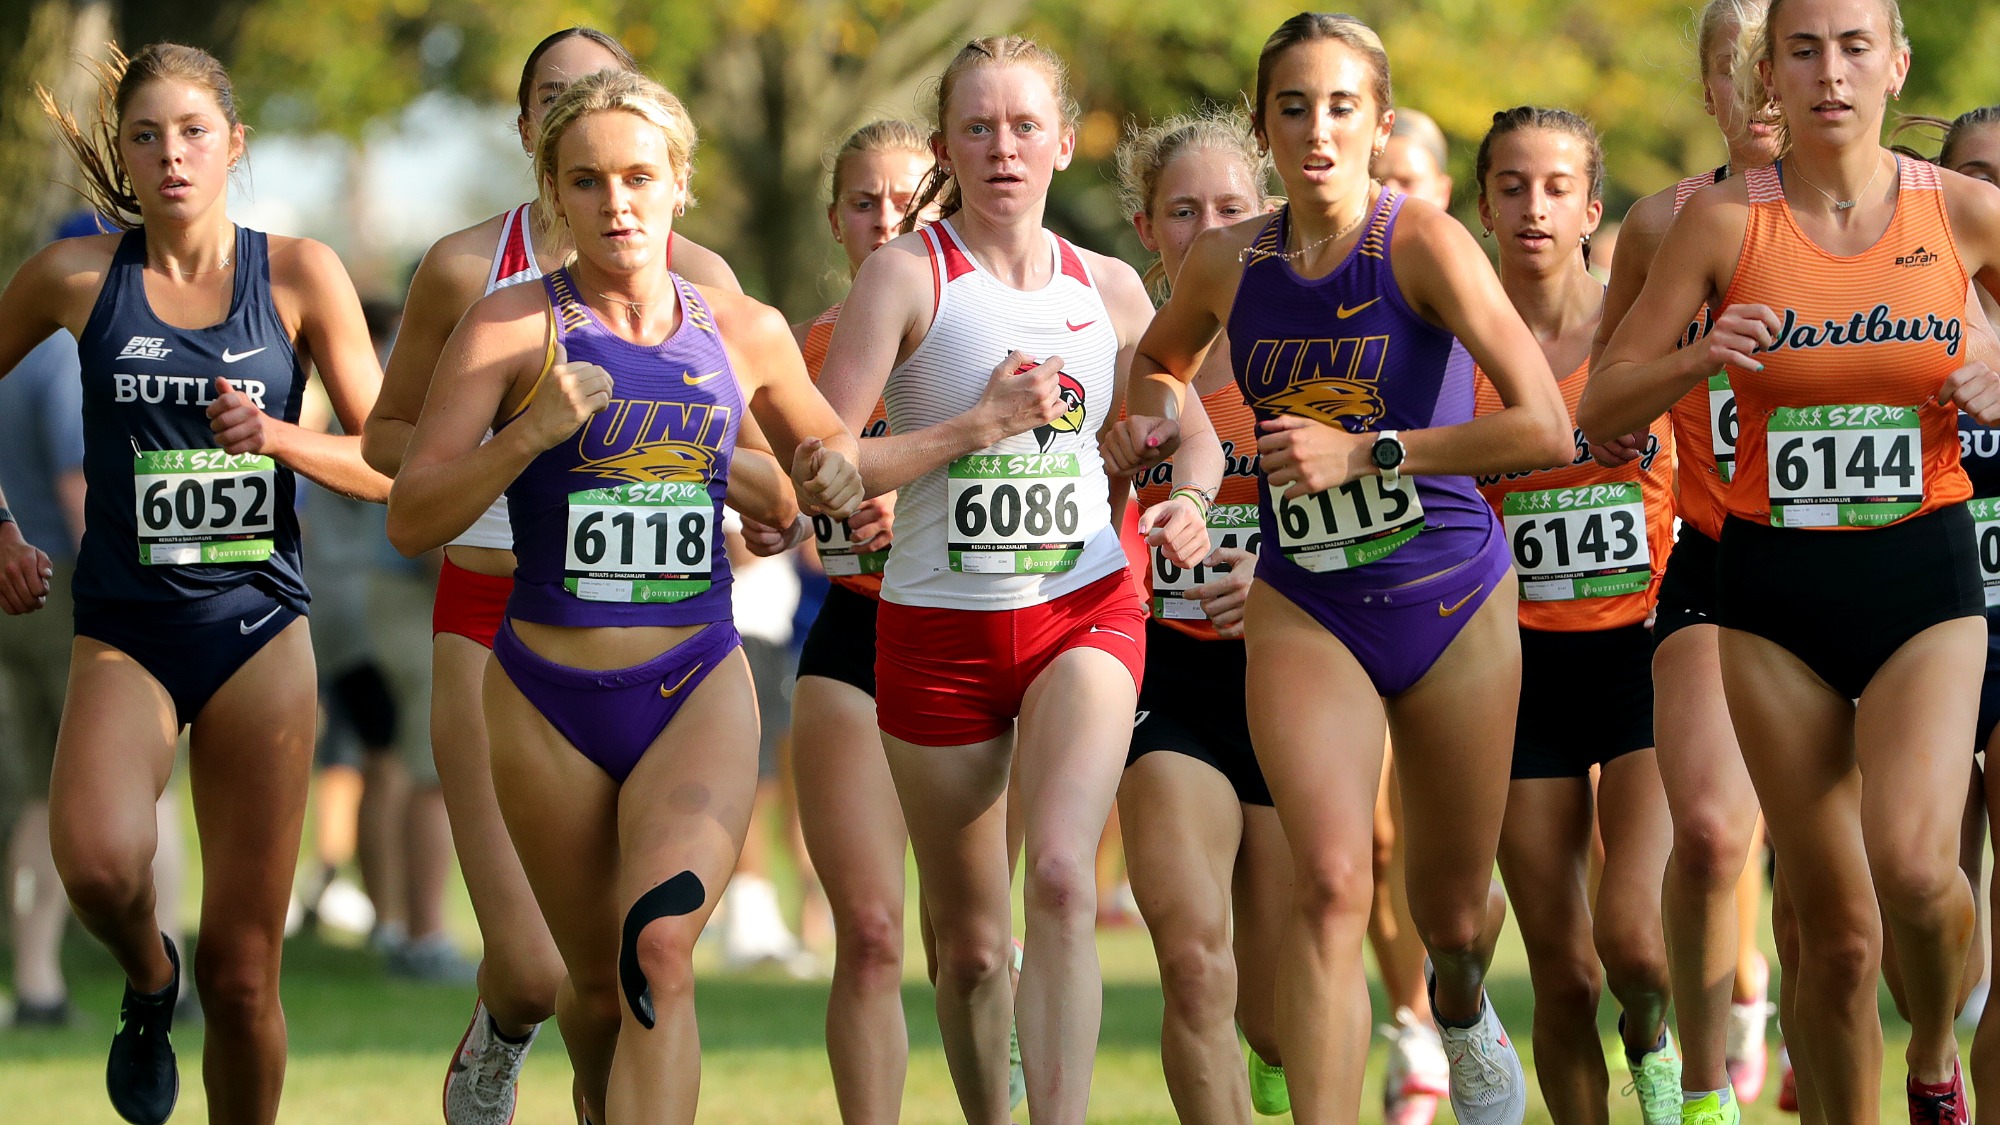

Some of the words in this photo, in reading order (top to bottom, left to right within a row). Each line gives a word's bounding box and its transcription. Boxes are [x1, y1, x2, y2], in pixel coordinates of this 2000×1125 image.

[119, 346, 173, 358] EAST
[127, 336, 165, 348] BIG
[1245, 335, 1390, 401] UNI
[578, 399, 731, 463] UNI
[1775, 434, 1915, 491] 6144
[143, 476, 268, 531] 6052
[954, 482, 1079, 538] 6086
[1279, 475, 1410, 540] 6115
[573, 511, 706, 566] 6118
[1513, 510, 1638, 569] 6143
